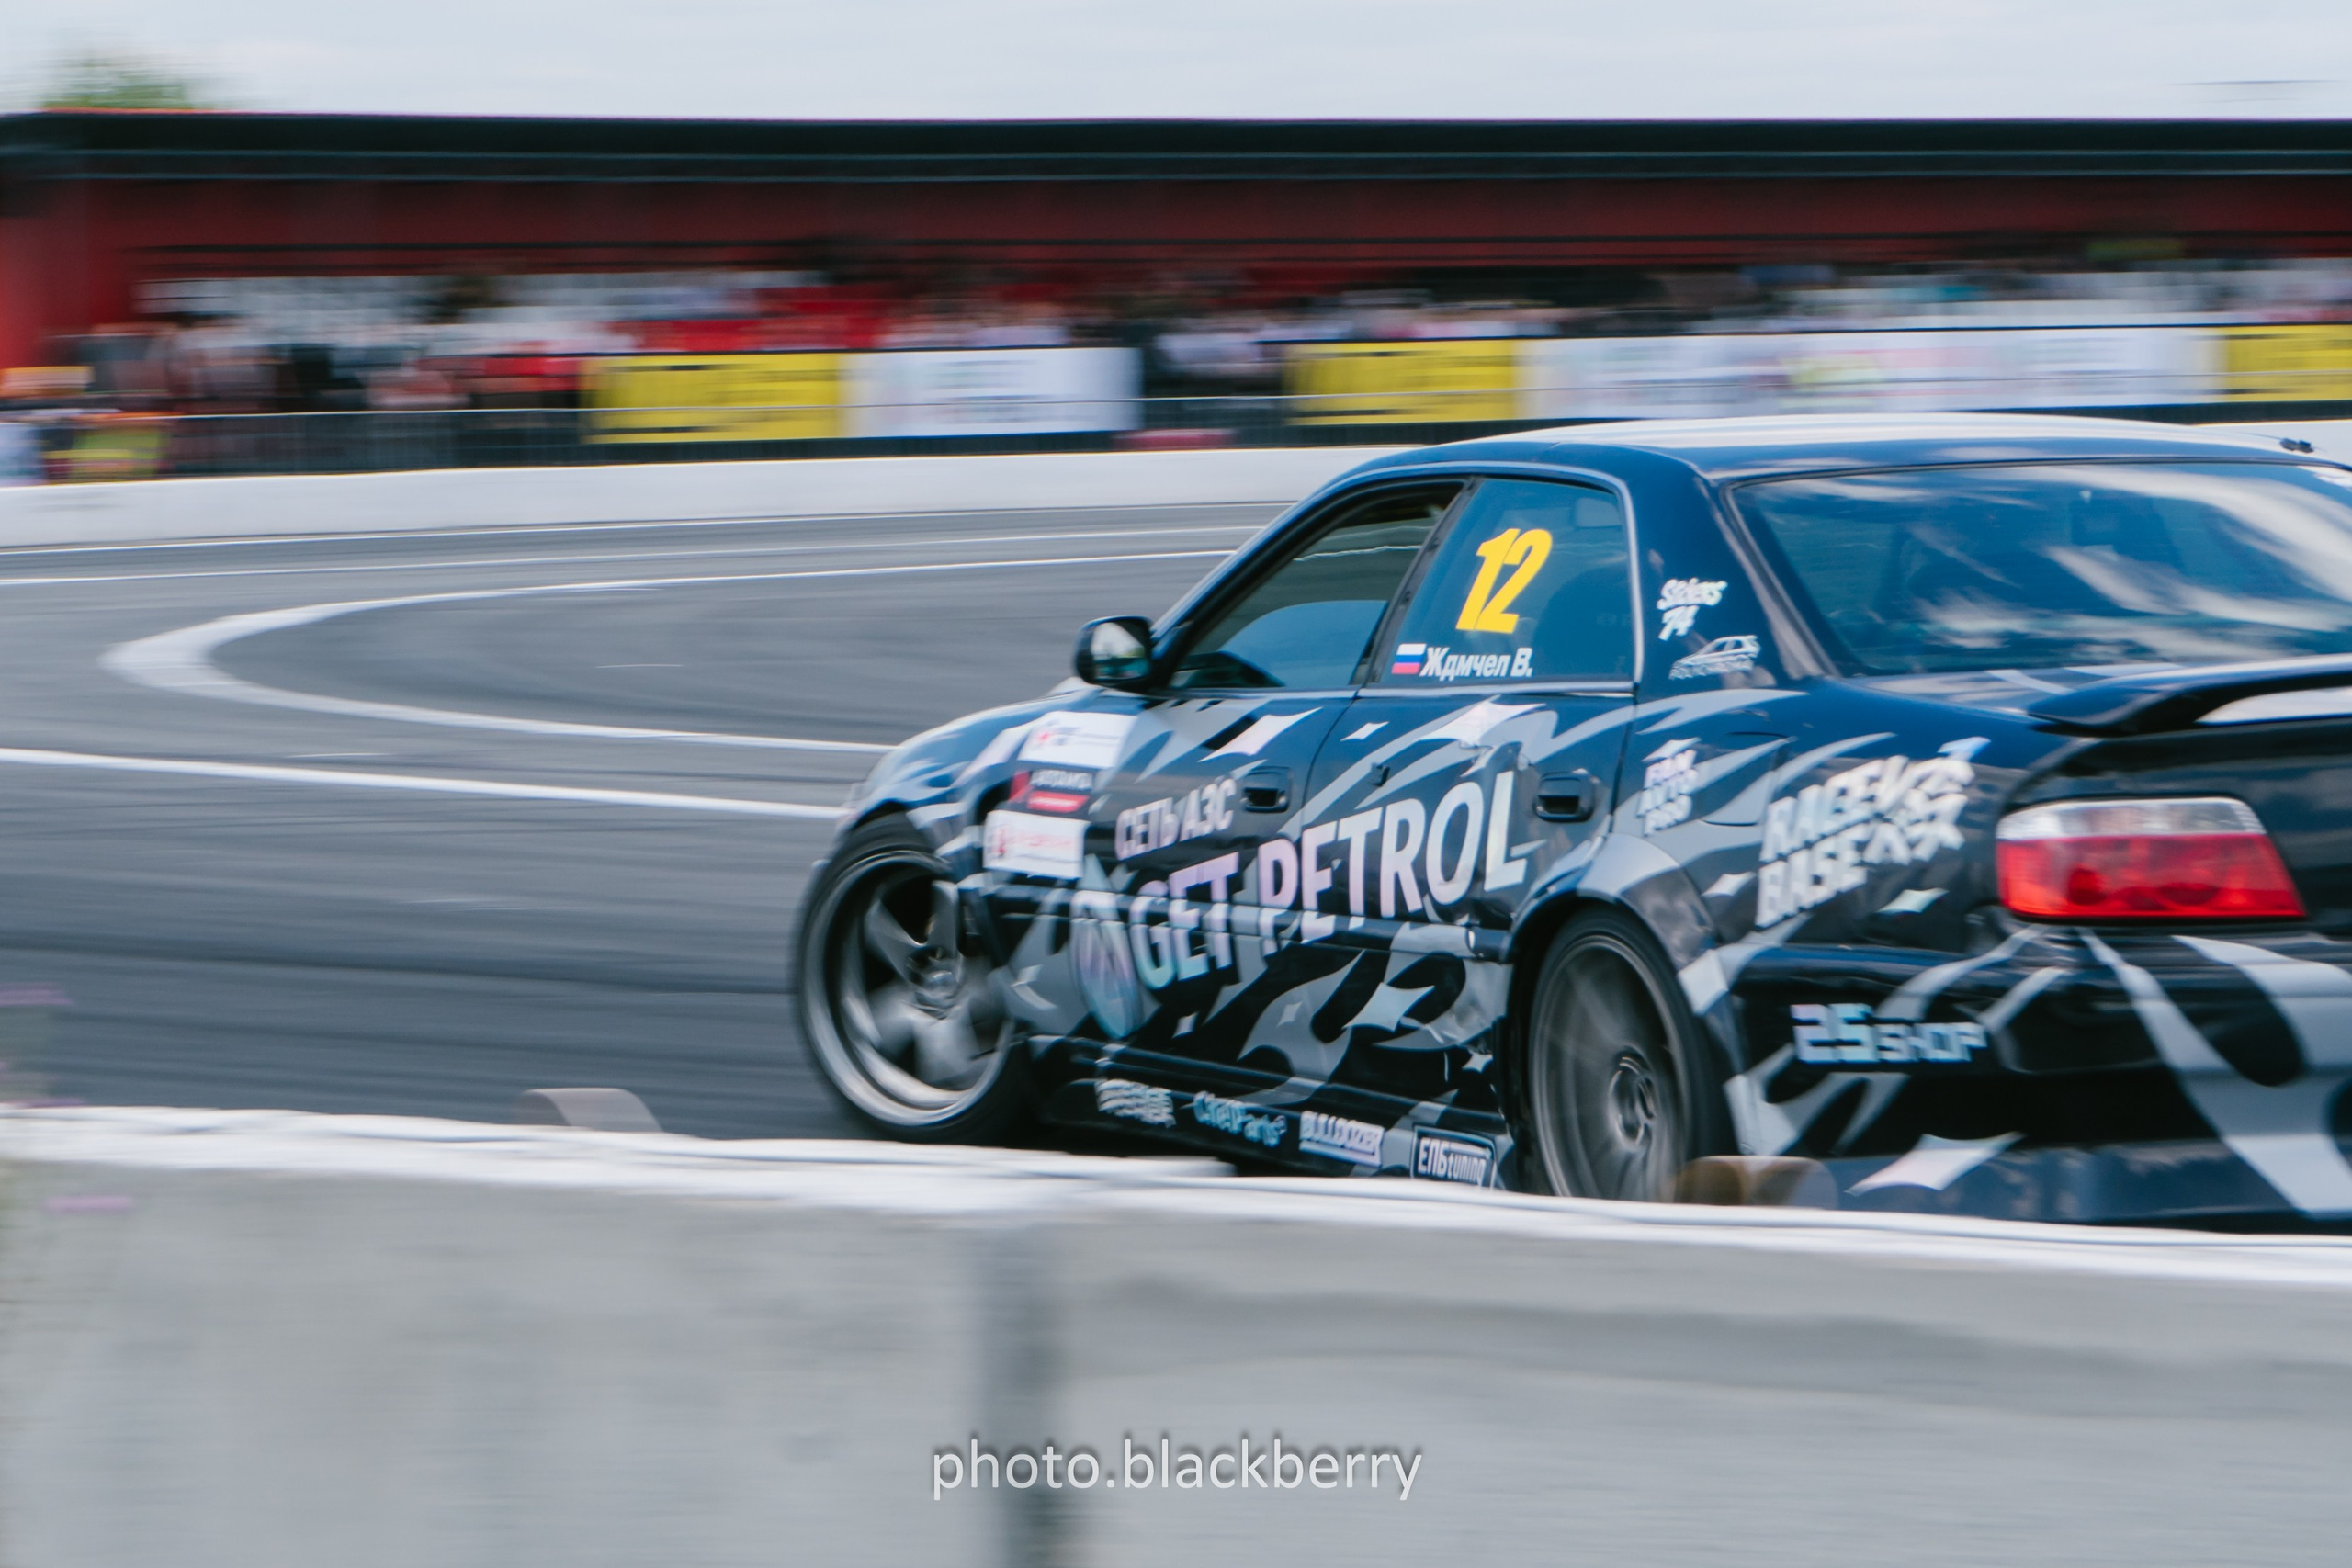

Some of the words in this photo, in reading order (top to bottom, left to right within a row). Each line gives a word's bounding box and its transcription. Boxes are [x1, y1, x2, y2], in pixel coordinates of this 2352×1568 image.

[1455, 528, 1553, 634] 12
[1115, 796, 1180, 860] СЕТЬ
[1180, 779, 1237, 841] АЗС
[1129, 852, 1239, 990] GET
[1258, 770, 1530, 956] PETROL
